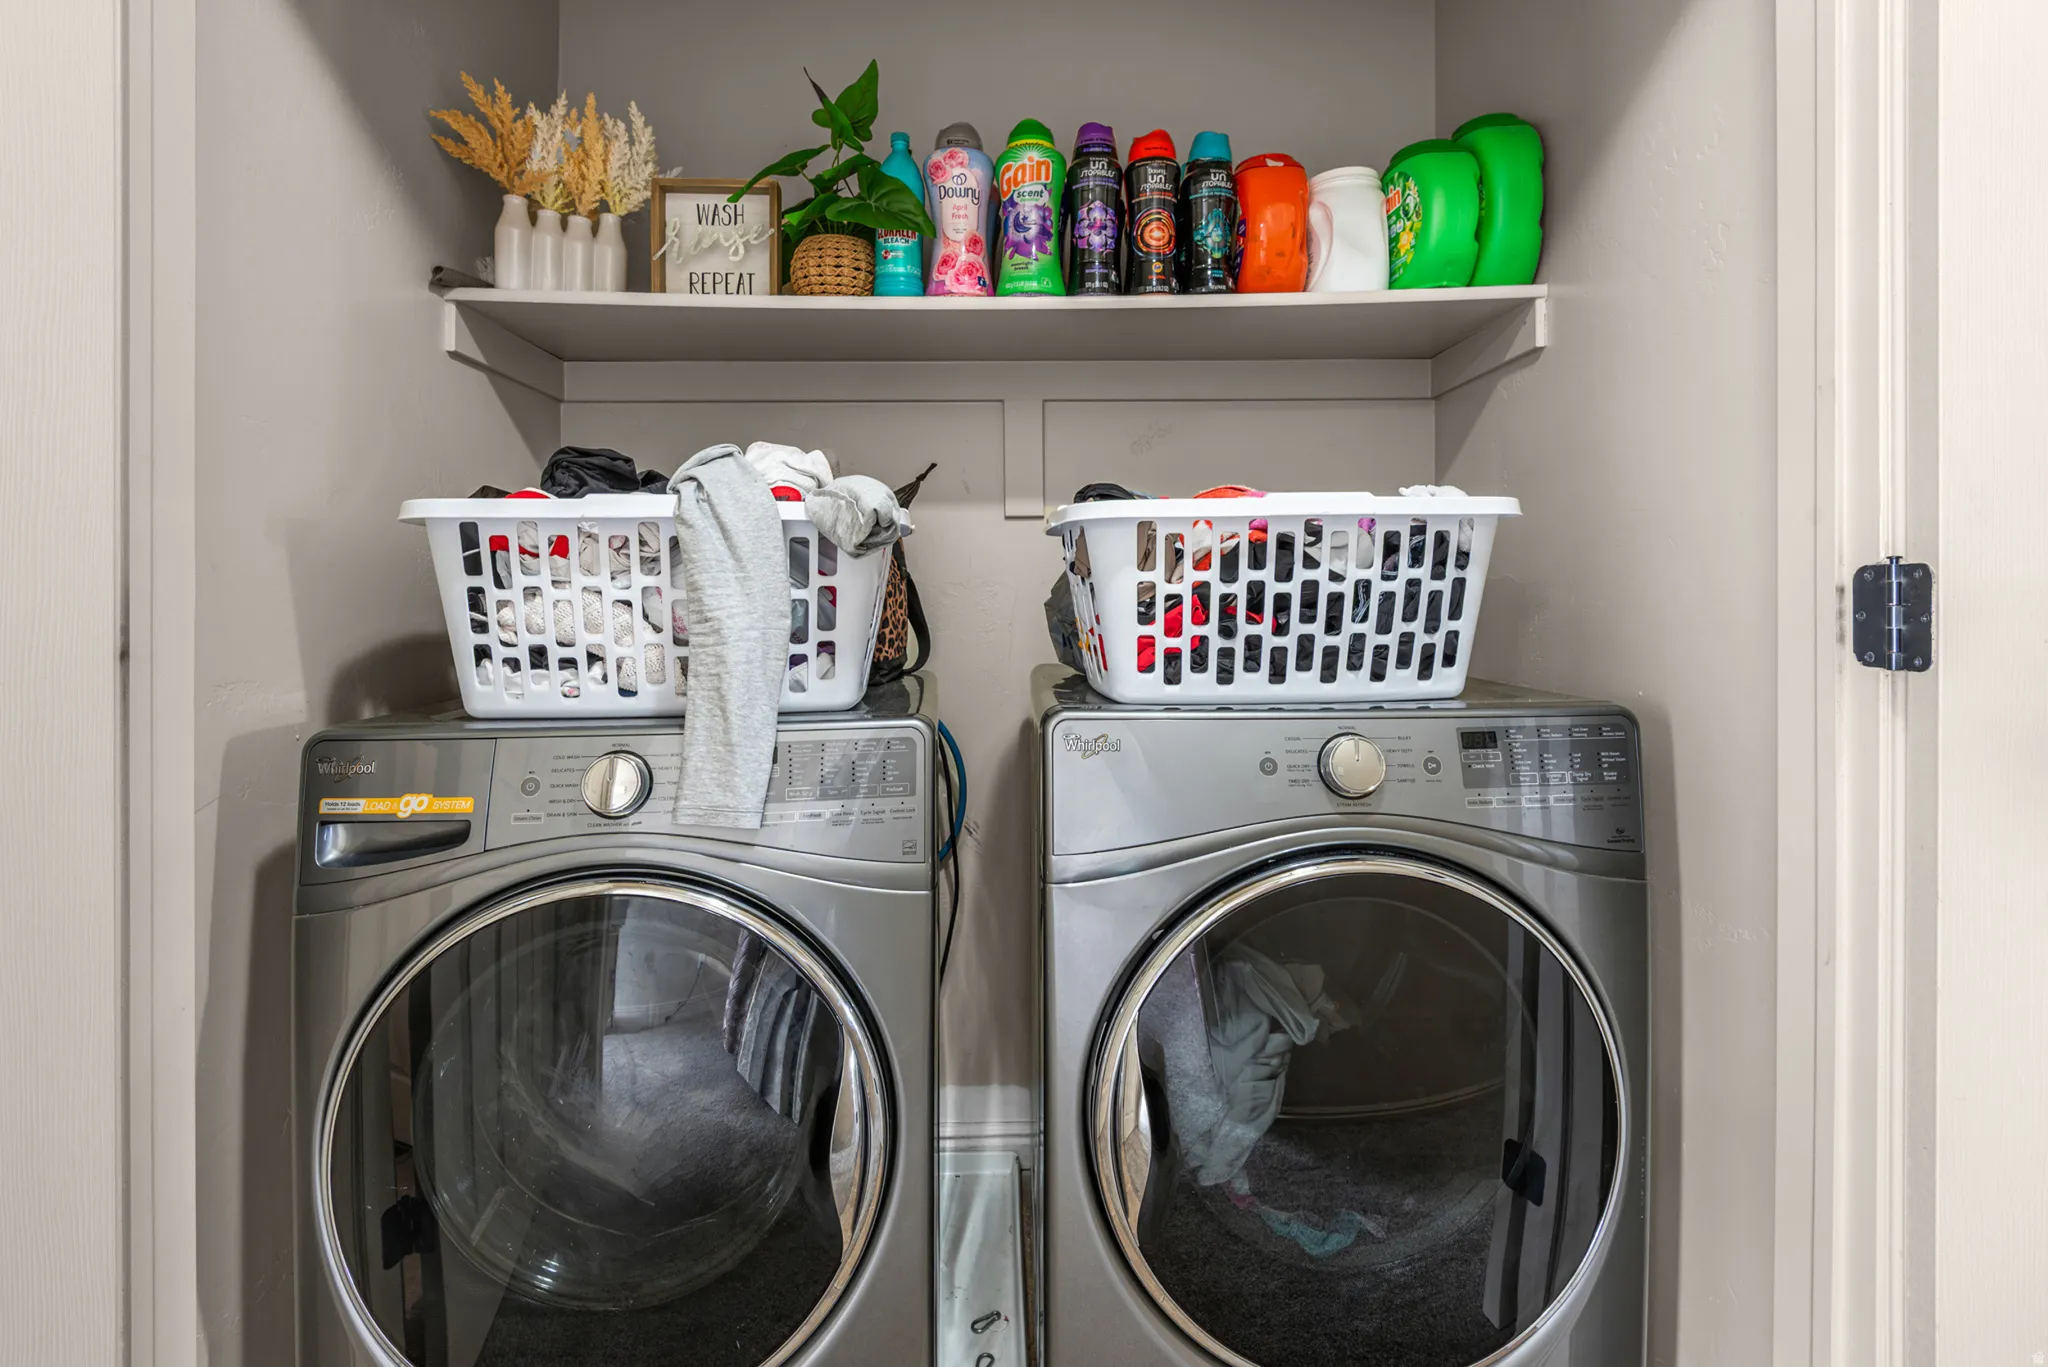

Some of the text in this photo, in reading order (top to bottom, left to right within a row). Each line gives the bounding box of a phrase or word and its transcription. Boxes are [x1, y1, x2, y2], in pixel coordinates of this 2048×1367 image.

[1000, 155, 1052, 200] Gain
[1080, 169, 1116, 178] STOPABLES
[938, 184, 981, 206] Downy
[1016, 189, 1045, 199] scent
[1140, 183, 1174, 191] STOPABLES
[696, 203, 745, 227] WASH
[952, 203, 968, 211] April
[951, 212, 969, 220] Fresh
[883, 237, 910, 245] BLEACH
[688, 271, 756, 295] REPEAT
[1064, 738, 1121, 754] Whirlpool
[316, 760, 376, 779] Whirlpool
[363, 801, 391, 811] LOAD
[397, 795, 429, 818] go
[432, 799, 471, 810] SYSTEM
